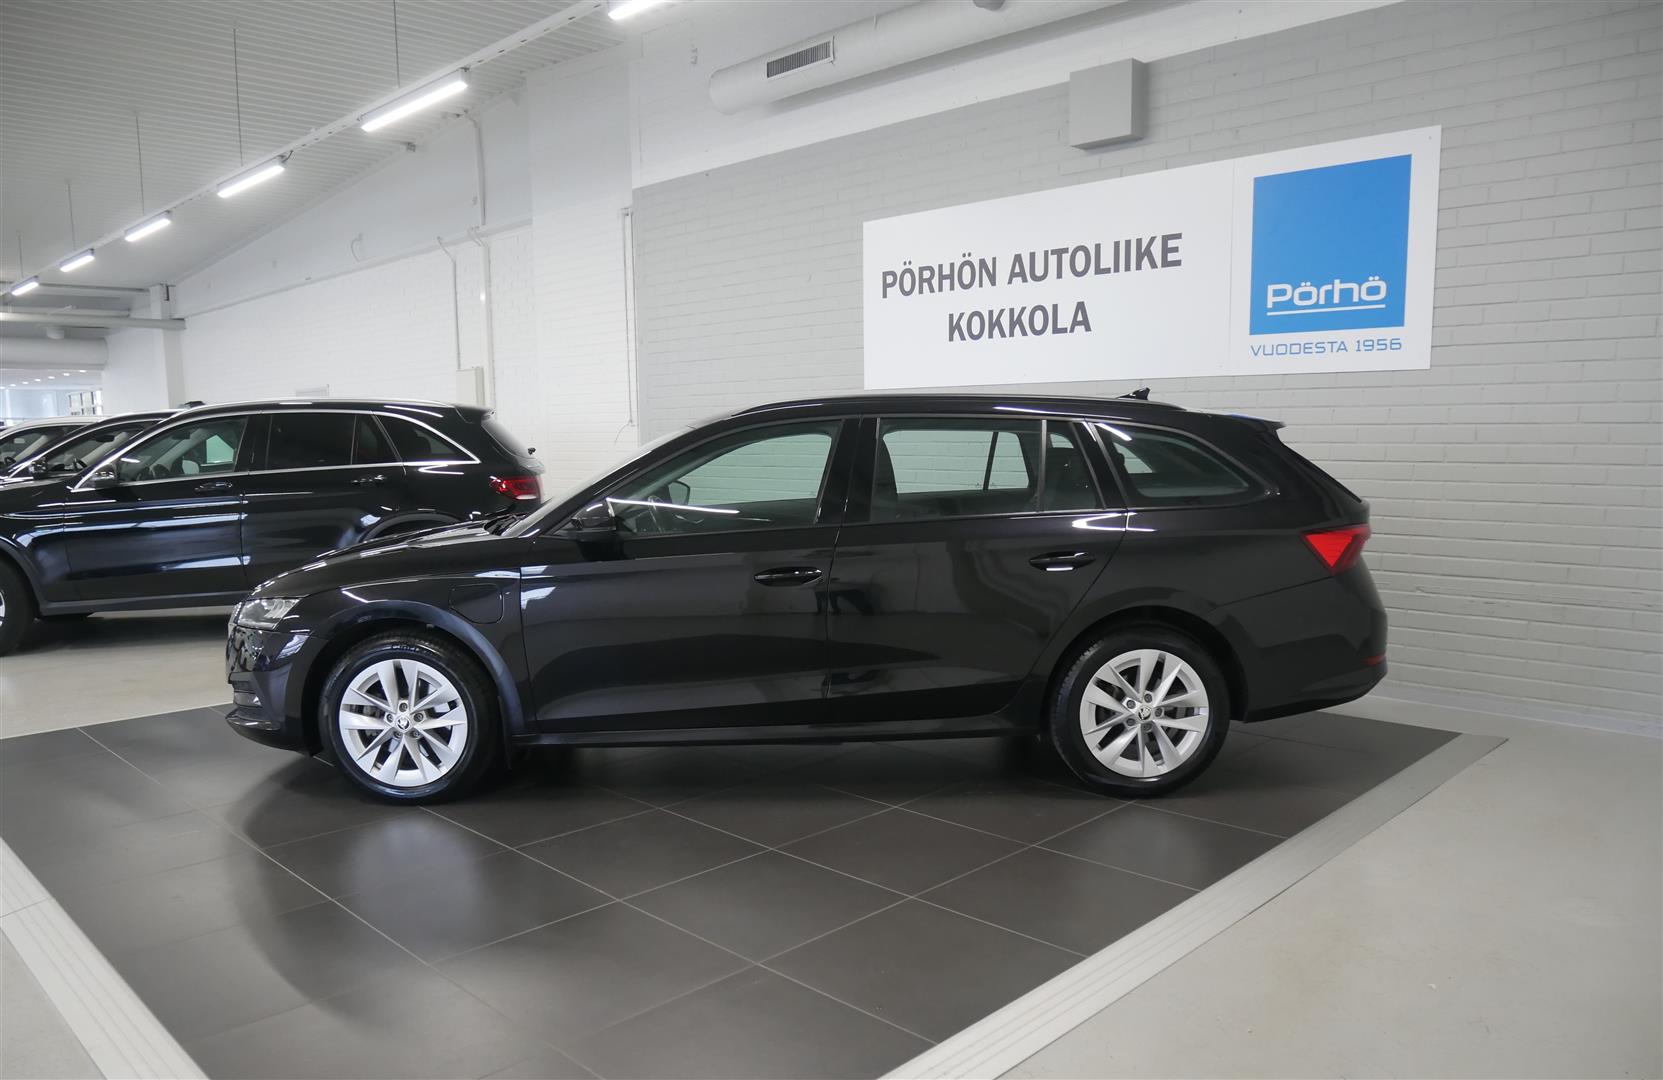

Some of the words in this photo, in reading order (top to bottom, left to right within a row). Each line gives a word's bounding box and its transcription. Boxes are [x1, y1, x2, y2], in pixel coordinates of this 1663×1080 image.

[882, 252, 997, 299] PÖRHÖN
[1007, 233, 1183, 285] AUTOLIIKE
[1266, 275, 1388, 309] Pörhö
[948, 301, 1092, 342] KOKKOLA
[1250, 340, 1348, 357] VUODESTA
[1355, 338, 1402, 352] 1956
